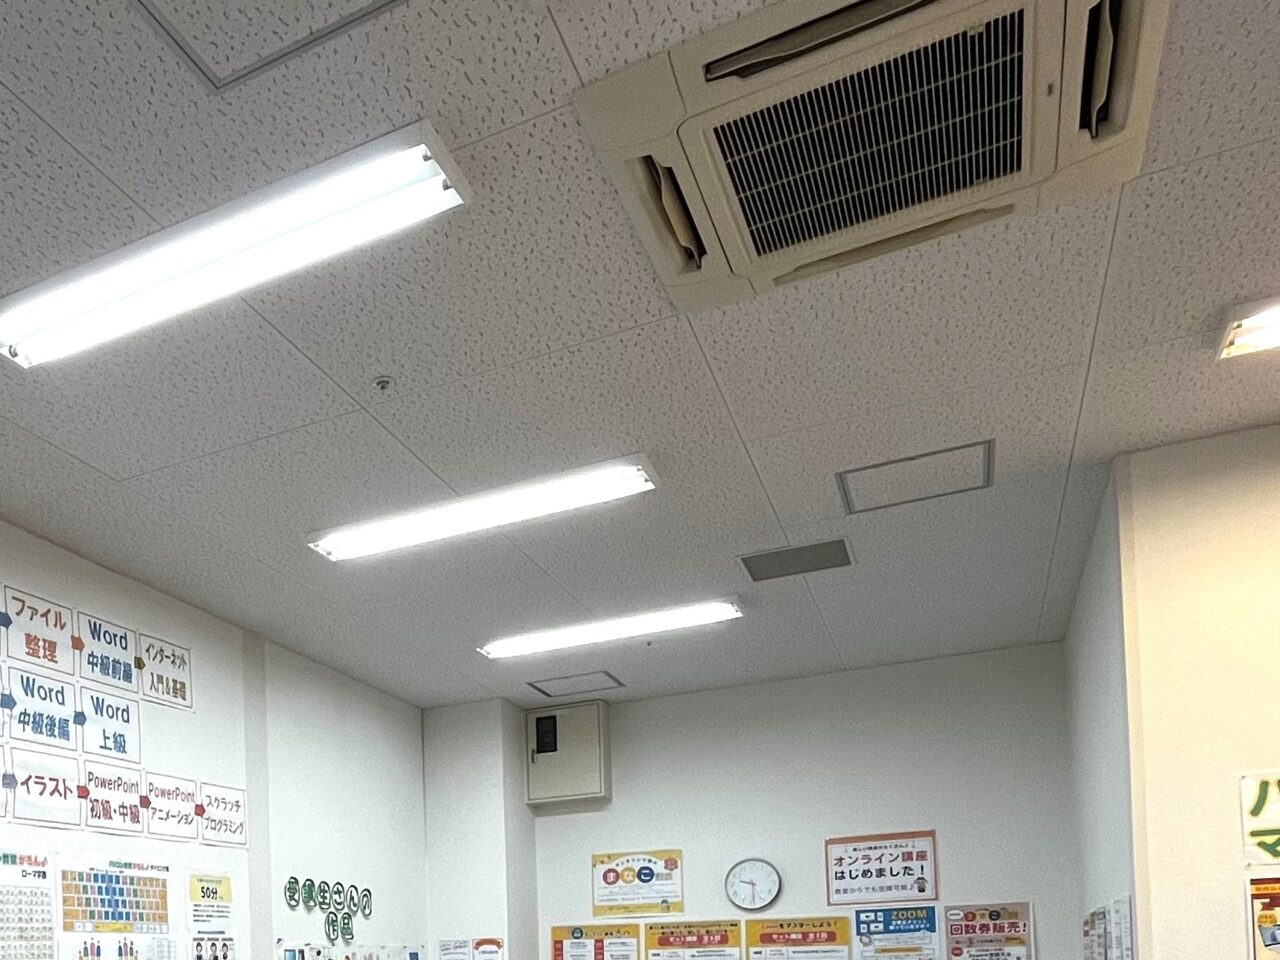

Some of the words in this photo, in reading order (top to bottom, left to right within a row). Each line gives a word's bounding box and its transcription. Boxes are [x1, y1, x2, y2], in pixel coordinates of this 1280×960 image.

[11, 595, 67, 632] ファイル
[87, 618, 129, 652] Word
[24, 632, 59, 665] 整理
[86, 650, 134, 685] 中級前編
[19, 673, 67, 707] Word
[90, 694, 131, 724] Word
[17, 707, 71, 742] 中級後編
[99, 728, 128, 754] 上級
[19, 773, 75, 801] イラスト
[87, 770, 140, 796] PowerPoint
[147, 781, 197, 804] PowerPoint
[88, 798, 141, 825] 初級・中級
[205, 794, 243, 812] スクラッチ
[833, 850, 928, 868] オンライン講座
[834, 864, 925, 881] はじめました!
[200, 885, 219, 900] 50分
[891, 909, 928, 920] ZOOM
[949, 921, 1027, 936] 回数券販売!
